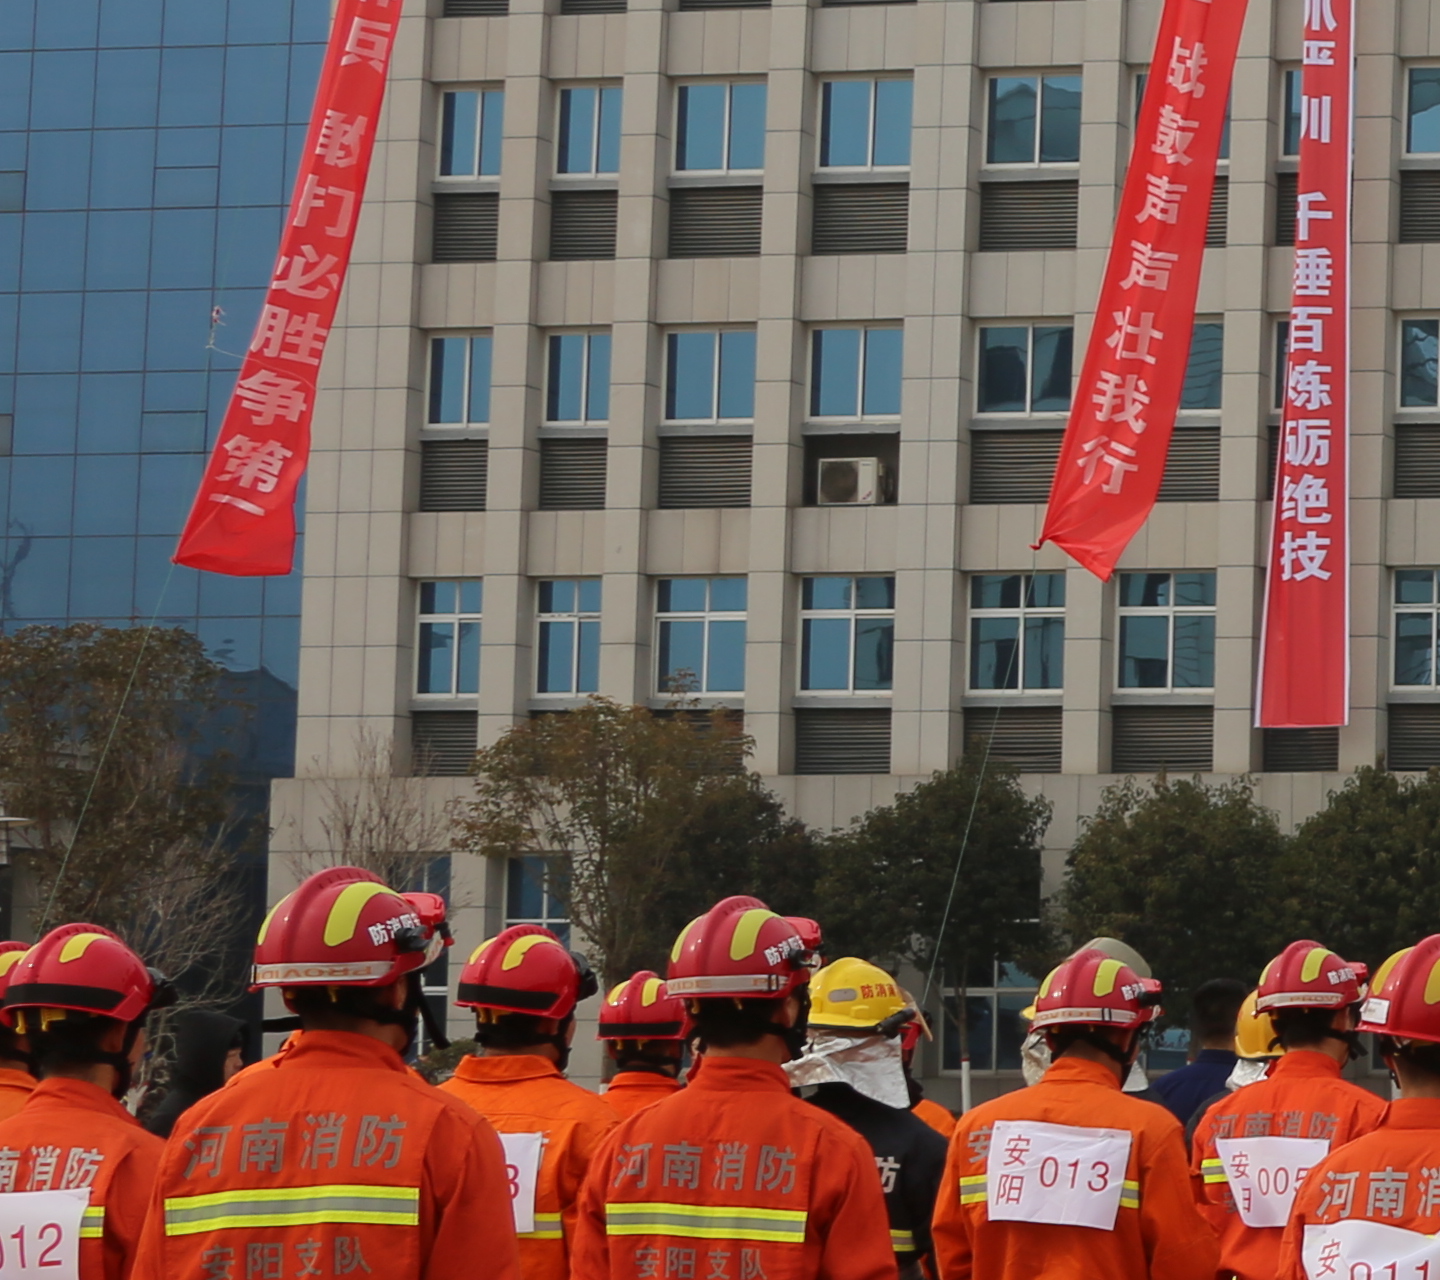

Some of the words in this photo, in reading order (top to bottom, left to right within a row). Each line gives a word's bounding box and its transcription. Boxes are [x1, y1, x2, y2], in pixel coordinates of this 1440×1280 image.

[183, 1112, 408, 1182] 河南消防
[613, 1140, 799, 1194] 河南消防
[995, 1134, 1031, 1206] 安阳
[1039, 1156, 1111, 1194] 013
[0, 1222, 64, 1271] 12
